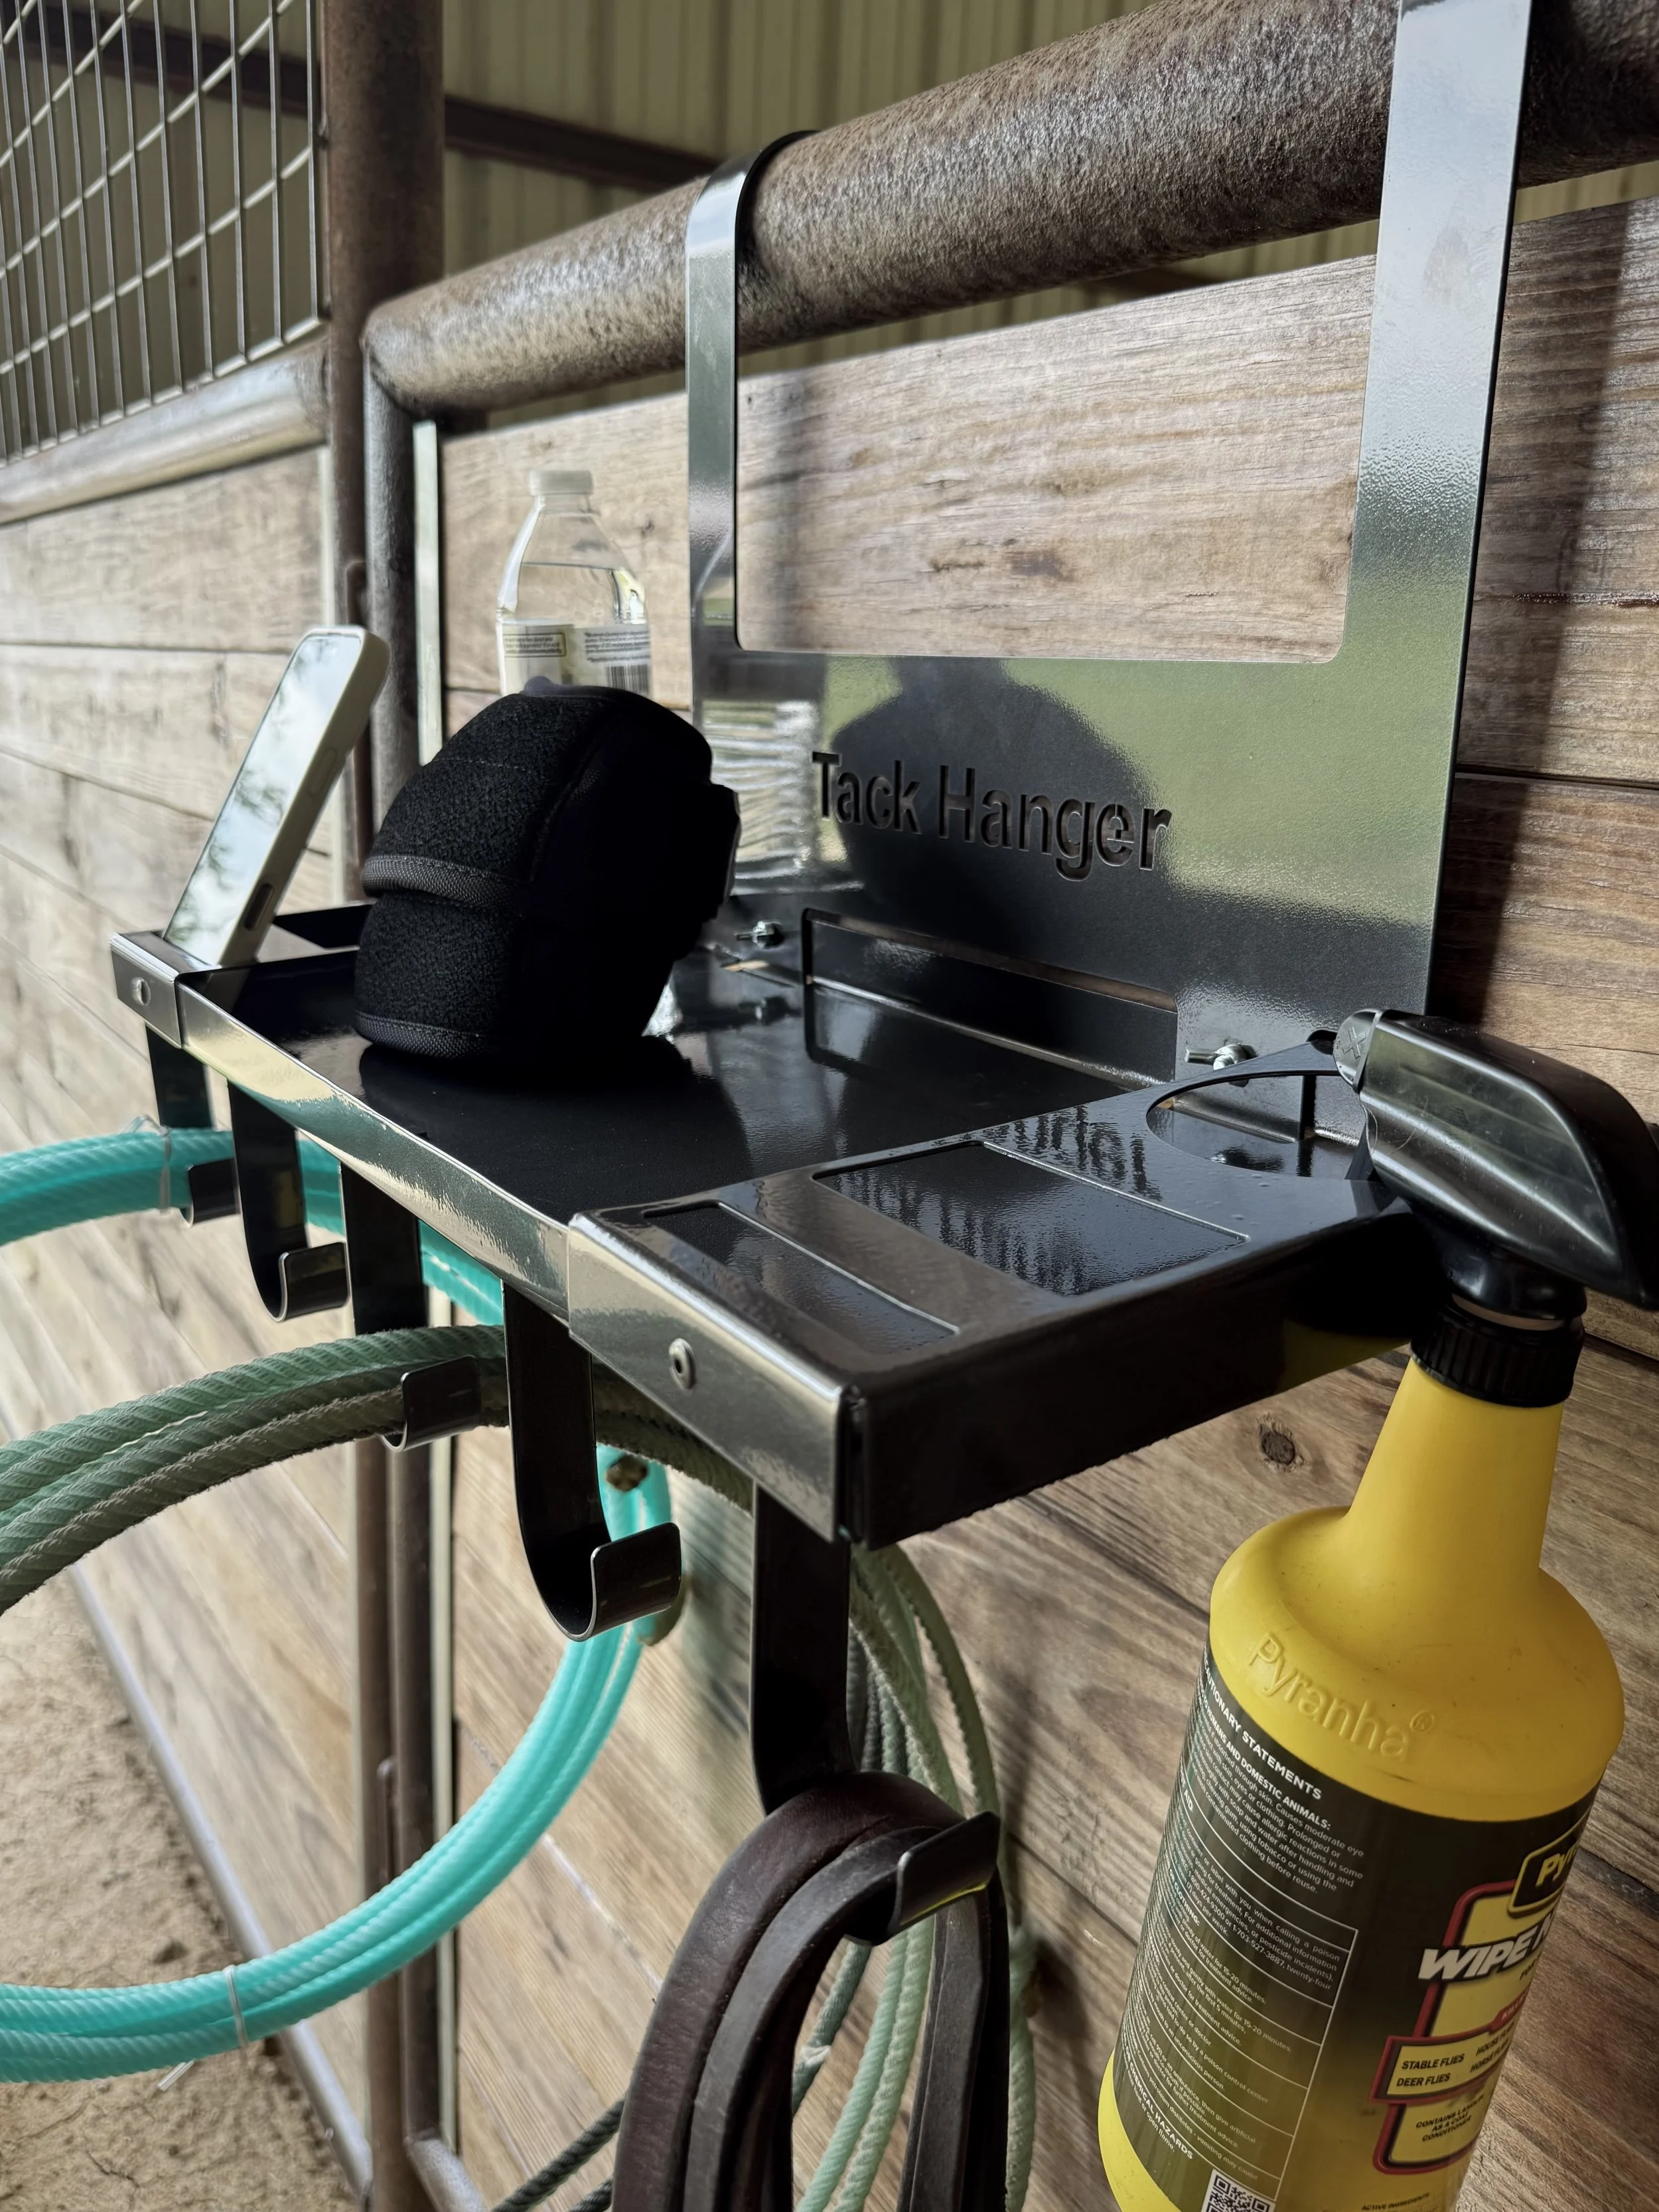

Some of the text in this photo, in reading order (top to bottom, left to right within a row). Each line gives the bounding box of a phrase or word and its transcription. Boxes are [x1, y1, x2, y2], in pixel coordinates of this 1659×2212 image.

[812, 751, 1173, 881] Tack Hanger
[1207, 1706, 1228, 1743] HUMANS
[1226, 1741, 1241, 1761] AND
[1241, 1757, 1282, 1800] DOMESTIC
[1283, 1796, 1331, 1830] ANIMALS:
[1242, 1730, 1322, 1800] STATEMENTS
[1206, 1792, 1239, 1836] contaminated
[1239, 1834, 1265, 1861] clothing
[1266, 1856, 1291, 1878] before
[1212, 1762, 1230, 1787] contact
[1230, 1785, 1242, 1802] may
[1242, 1799, 1261, 1819] cause
[1262, 1818, 1288, 1840] allergic
[1289, 1838, 1327, 1863] reactions
[1329, 1858, 1337, 1869] in
[1338, 1865, 1364, 1879] some
[1219, 1783, 1354, 1887] with soap and water after handling and
[1234, 1777, 1248, 1795] eyes
[1248, 1793, 1256, 1802] or
[1287, 1823, 1330, 1852] Prolonged
[1235, 1765, 1258, 1793] through
[1275, 1803, 1303, 1827] Causes
[1305, 1824, 1346, 1849] moderate
[1347, 1846, 1364, 1857] eye
[1240, 1822, 1258, 1842] using
[1258, 1838, 1287, 1863] tobacco
[1288, 1861, 1297, 1870] or
[1298, 1868, 1321, 1884] using
[1323, 1880, 1337, 1891] the
[1174, 1881, 1200, 1926] CLOTHING:
[1194, 1868, 1212, 1894] medical
[1260, 1937, 1292, 1960] pesticide
[1194, 1857, 1207, 1878] going
[1244, 1911, 1255, 1924] For
[1256, 1923, 1292, 1949] additional
[1293, 1945, 1338, 1972] information
[1202, 1905, 1212, 1917] per
[1210, 1863, 1224, 1883] label
[1225, 1883, 1238, 1898] with
[1239, 1897, 1252, 1909] you
[1254, 1909, 1273, 1926] when
[1276, 1925, 1301, 1944] calling
[1312, 1945, 1340, 1962] poison
[1200, 1943, 1214, 1959] water
[1223, 1966, 1240, 1983] 15-20
[1205, 1957, 1232, 1986] treatment
[1225, 1918, 1232, 1927] or
[1287, 1964, 1332, 1990] twenty-four
[1417, 1925, 1539, 1980] WIPE
[1190, 1968, 1204, 1986] gently
[1204, 1985, 1216, 1999] with
[1216, 1997, 1233, 2014] water
[1234, 2011, 1243, 2022] for
[1244, 2018, 1262, 2035] 15-20
[1195, 1999, 1220, 2028] treatment
[1196, 1984, 1205, 1996] the
[1174, 2035, 1204, 2072] unconscious
[1179, 2026, 1186, 2035] do
[1186, 2033, 1192, 2043] so
[1192, 2040, 1200, 2051] by
[1204, 2053, 1224, 2073] poison
[1224, 2071, 1246, 2090] control
[1247, 2088, 1269, 2104] center
[1396, 2077, 1424, 2087] DEER
[1425, 2073, 1451, 2085] FLIES
[1402, 2059, 1440, 2070] STABLE
[1440, 2053, 1465, 2067] FLIES
[1129, 2061, 1155, 2114] CHEMICAL
[1155, 2112, 1193, 2160] HAZARDS
[1169, 2106, 1193, 2134] distillates
[1197, 2136, 1223, 2160] vomiting
[1223, 2157, 1237, 2169] may
[1173, 2086, 1189, 2106] further
[1189, 2105, 1217, 2134] treatment
[1202, 2099, 1215, 2116] then
[1215, 2114, 1229, 2126] give
[1230, 2124, 1256, 2144] artificial
